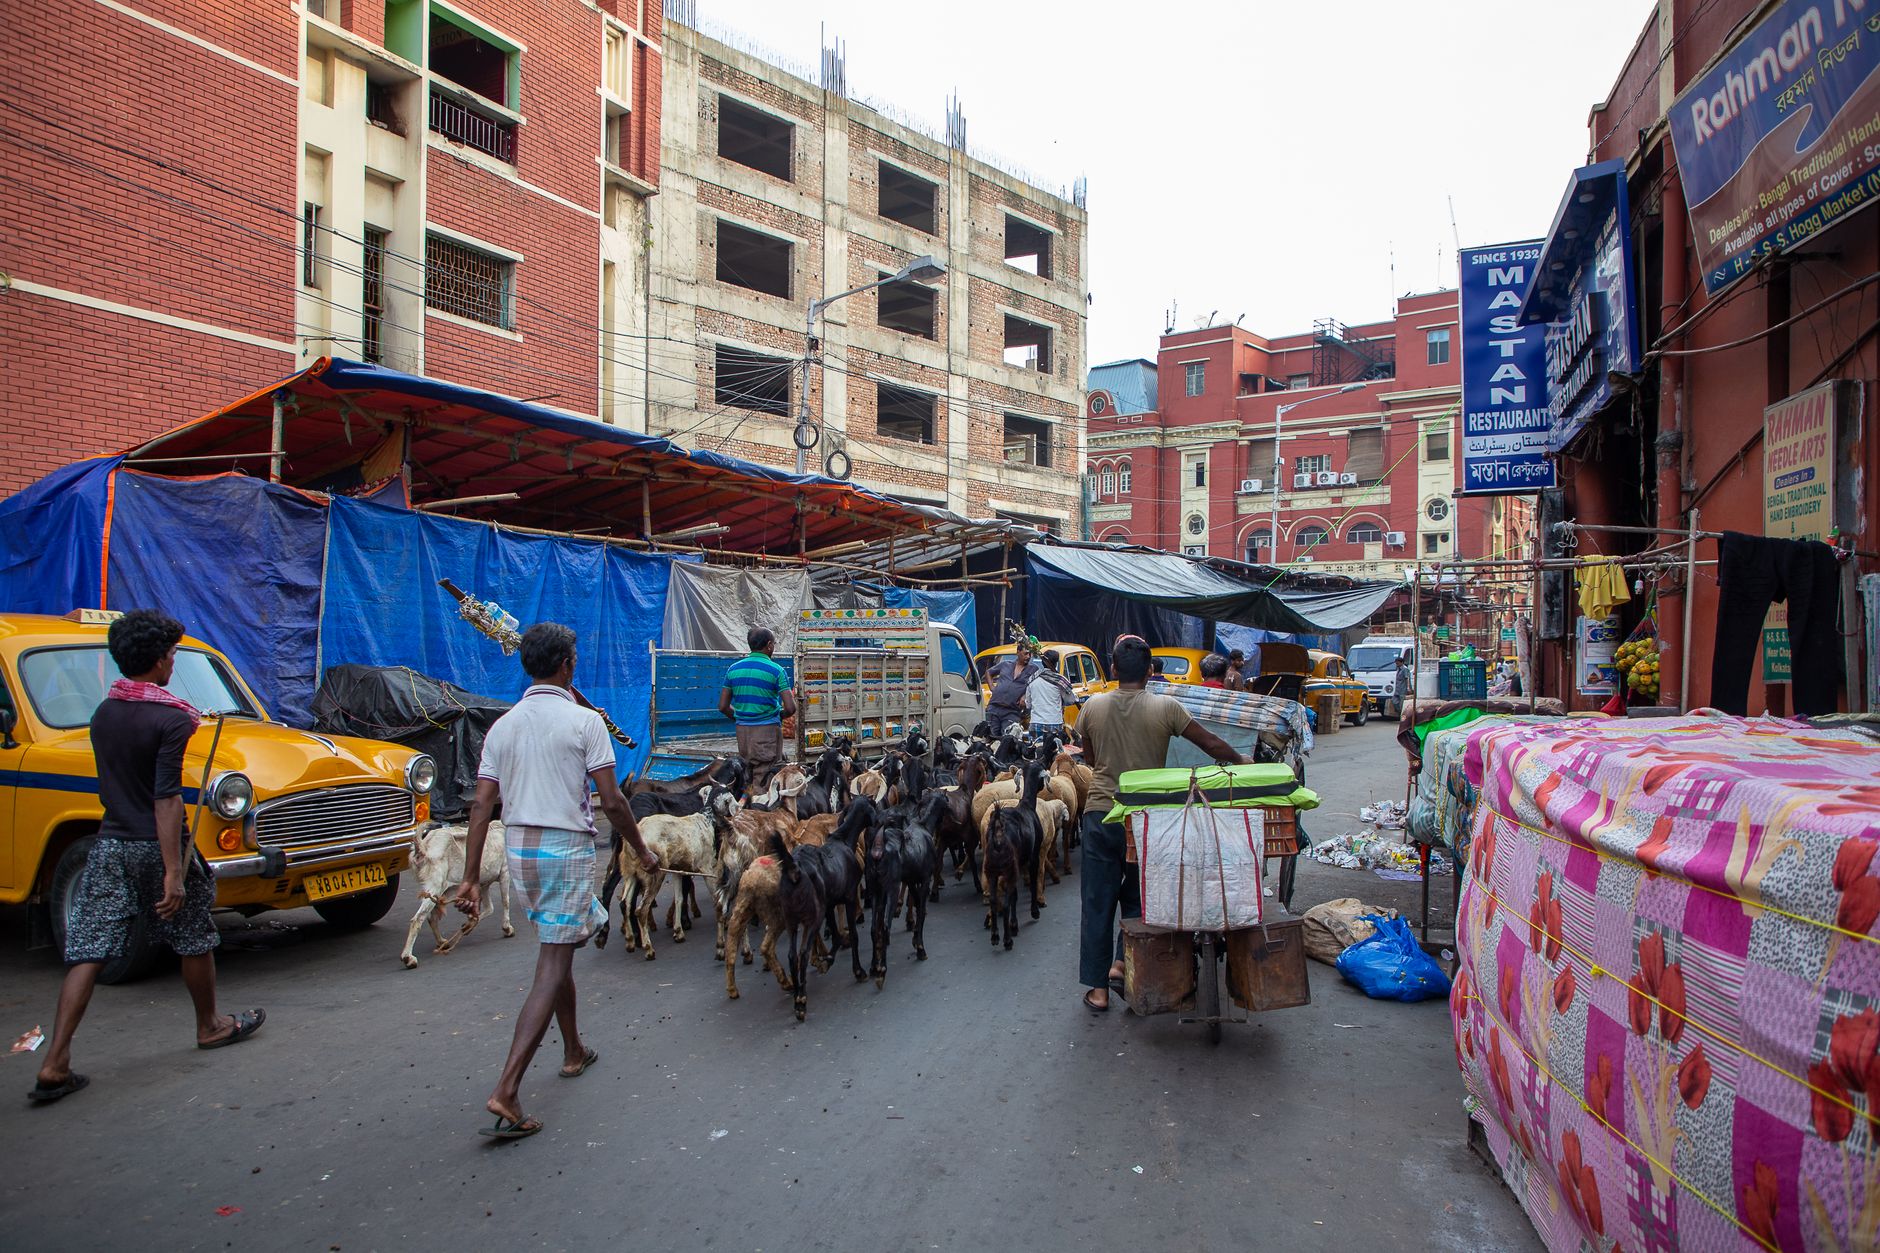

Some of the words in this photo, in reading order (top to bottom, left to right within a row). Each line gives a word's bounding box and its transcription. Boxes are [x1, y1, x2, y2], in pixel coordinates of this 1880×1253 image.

[1691, 6, 1823, 145] Rahman
[1709, 215, 1742, 245] Dealers
[1759, 175, 1791, 209] Bengal
[1791, 135, 1847, 186] Traditional
[1724, 222, 1765, 256] Available
[1765, 209, 1779, 228] all
[1778, 194, 1806, 221] types
[1807, 181, 1818, 200] of
[1820, 160, 1854, 191] Cover
[1789, 212, 1822, 241] Hogg
[1821, 183, 1868, 220] Market
[1472, 251, 1507, 265] SINCE
[1510, 248, 1539, 261] 1932
[1487, 265, 1527, 405] MASTAN
[1553, 293, 1593, 384] MASTAN
[1469, 408, 1548, 431] RESTAURANT
[1767, 392, 1827, 447] RAHMAN
[1469, 459, 1511, 483] মস্তান
[1767, 441, 1799, 473] NEEDLE
[1800, 432, 1827, 463] ARTS
[1767, 491, 1786, 509] BENGAL
[1787, 482, 1827, 503] TRADITIONAL
[1775, 474, 1800, 489] Dealers
[1769, 508, 1783, 523] HAND
[1785, 499, 1821, 520] EMBROIDERY
